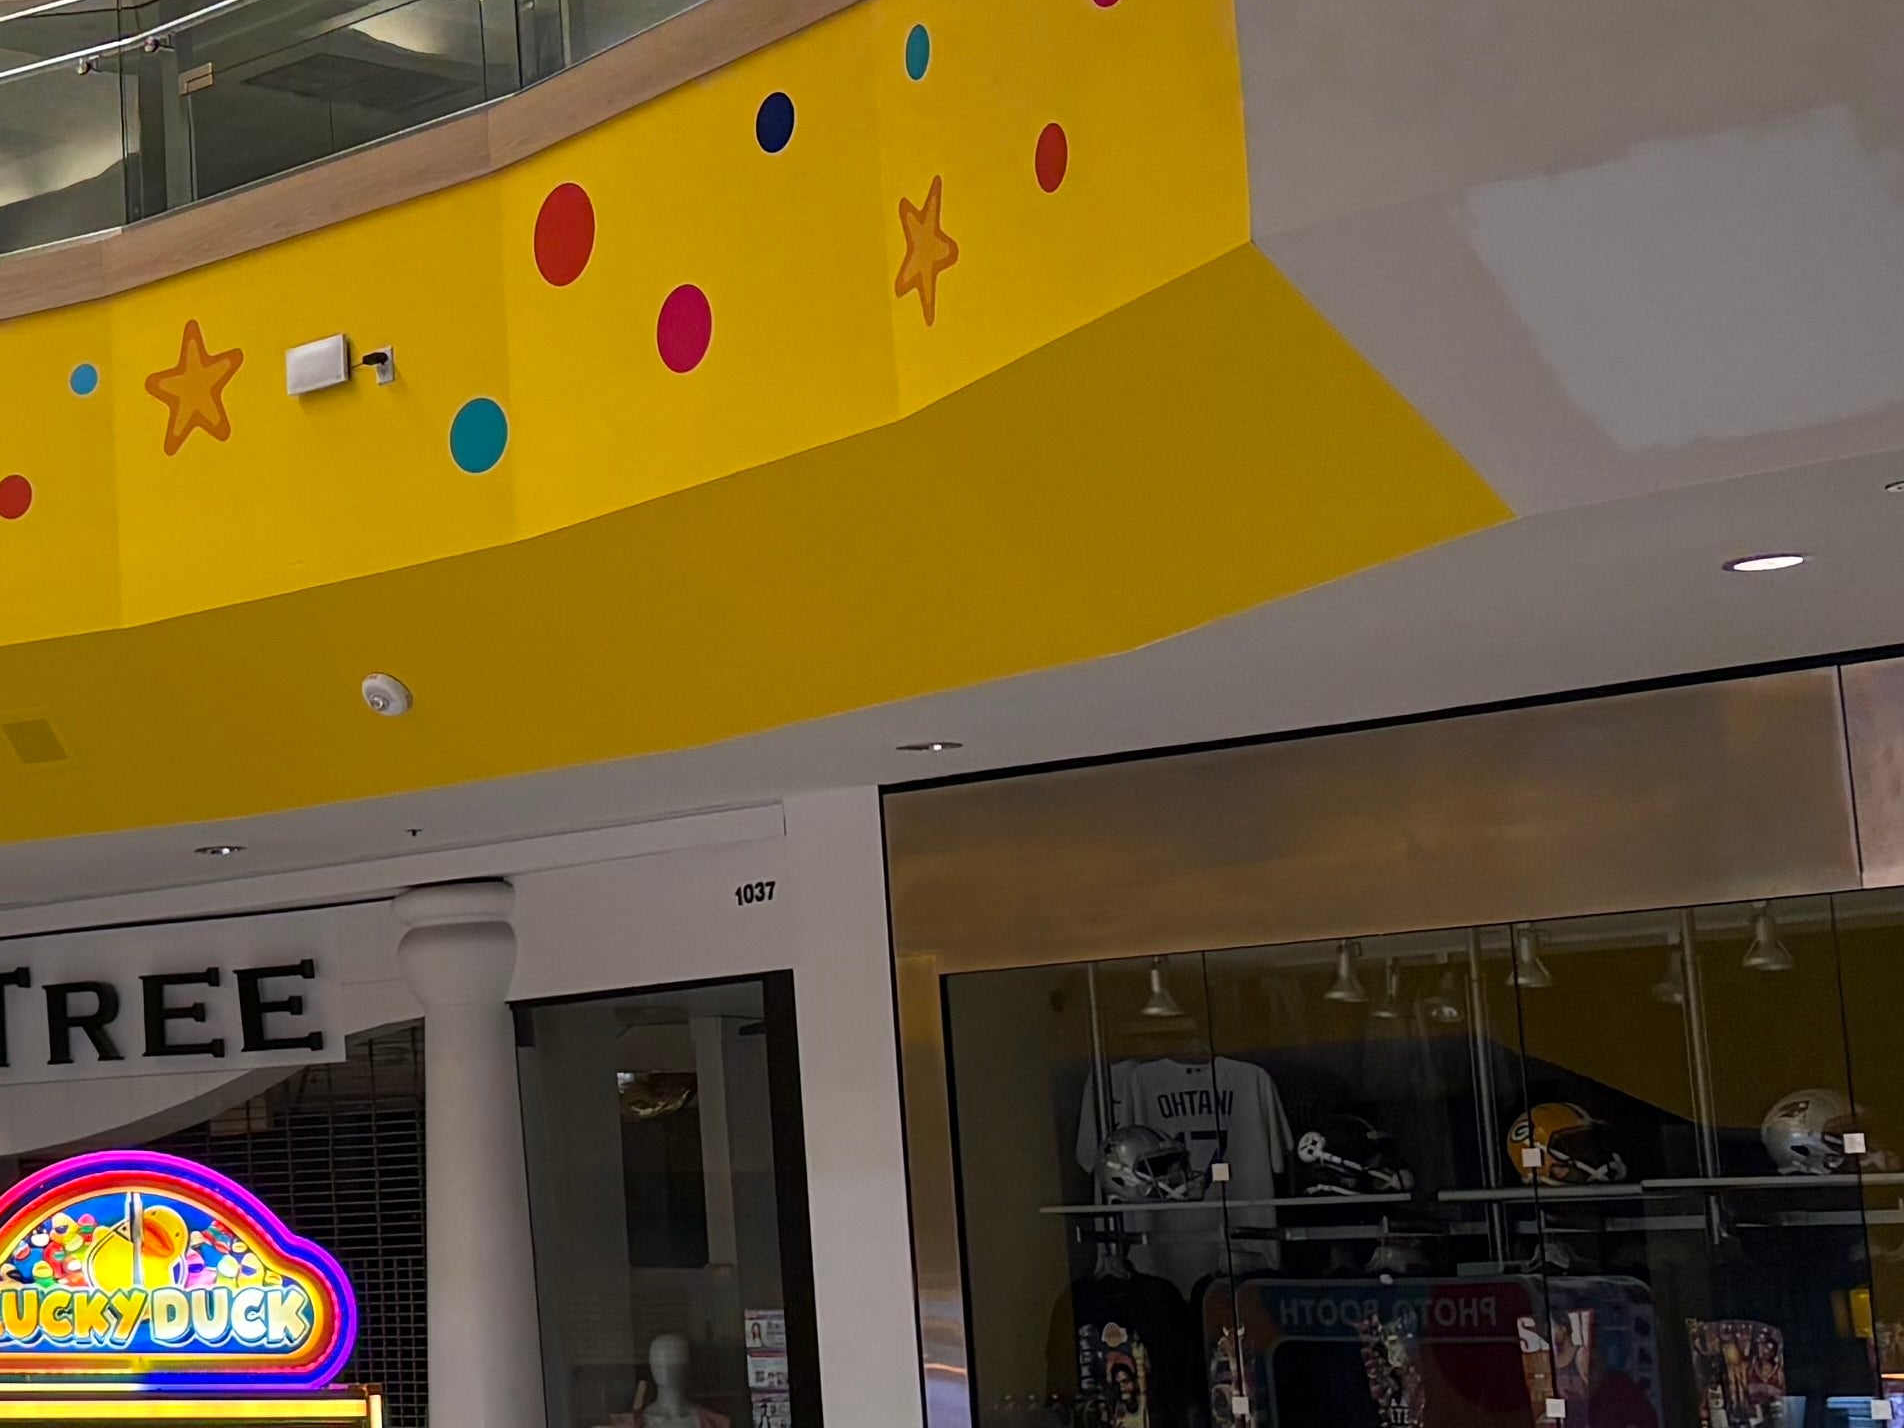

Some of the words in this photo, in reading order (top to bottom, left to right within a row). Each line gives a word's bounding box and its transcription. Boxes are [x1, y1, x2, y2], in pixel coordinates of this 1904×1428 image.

[734, 880, 778, 906] 1037
[1157, 1089, 1234, 1119] OHTANI
[149, 1283, 312, 1346] DUCK
